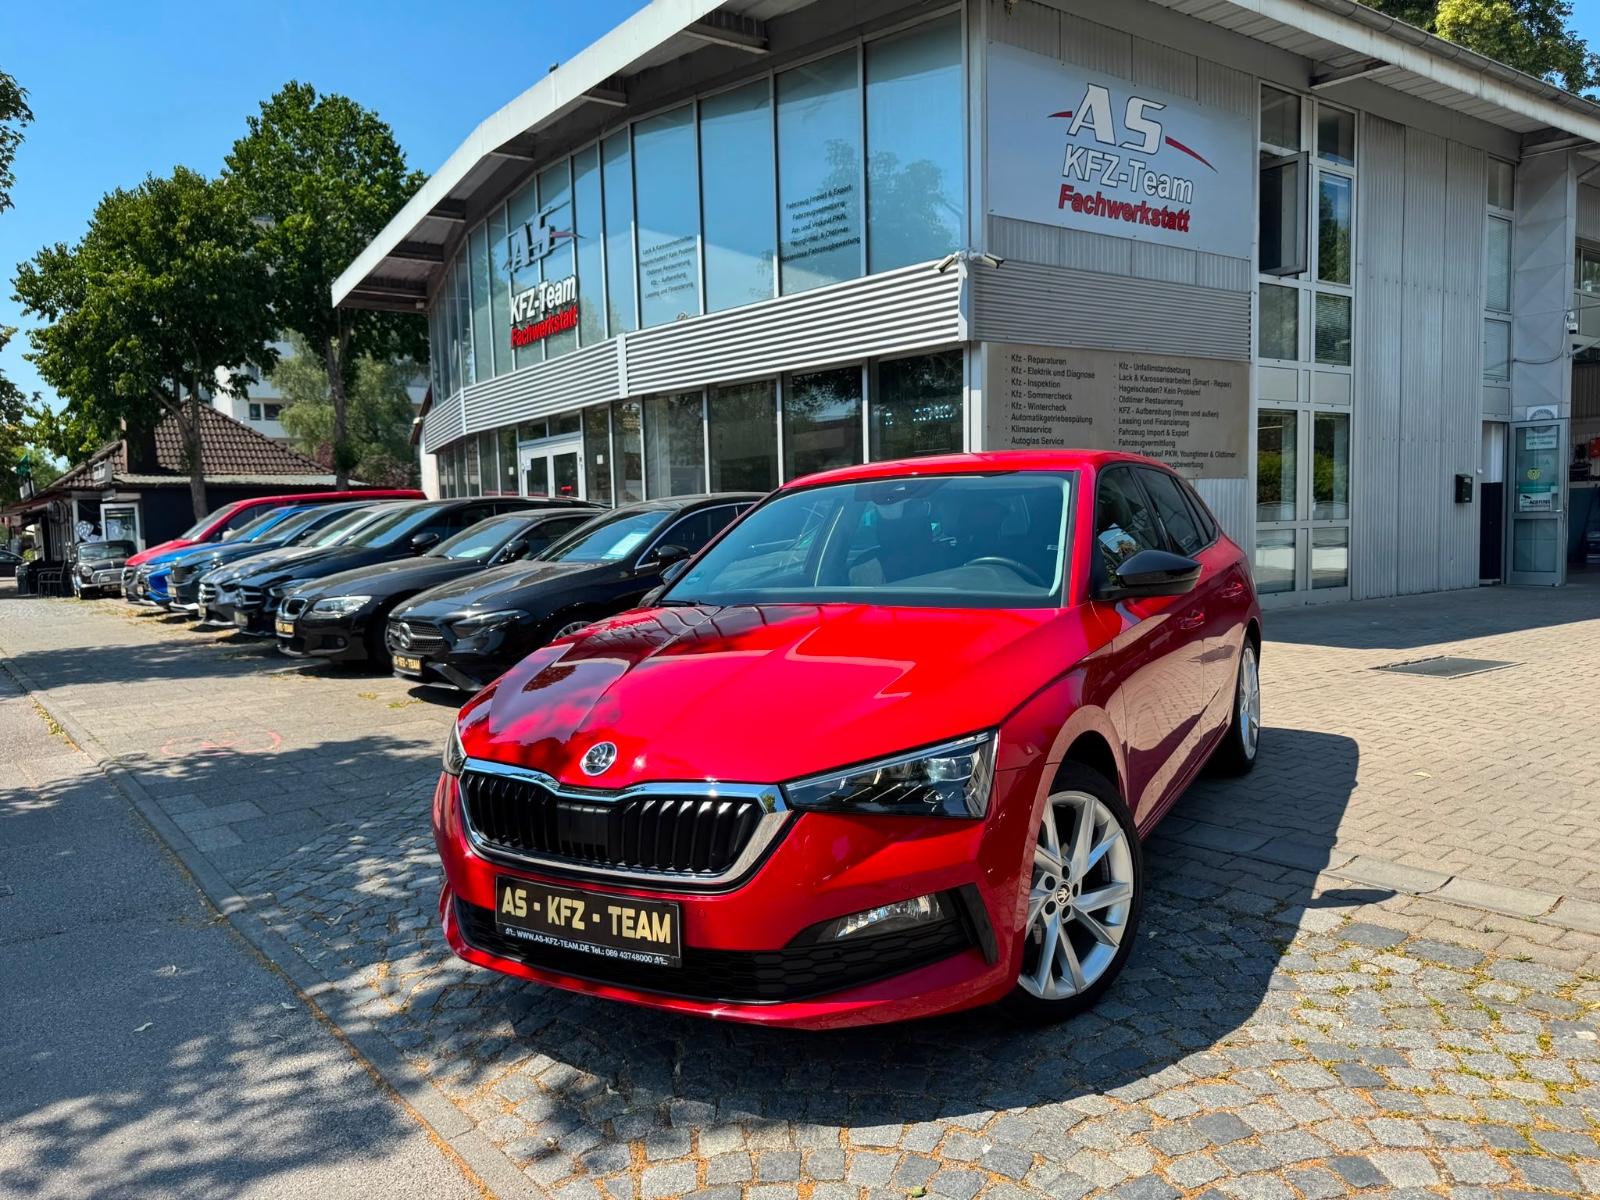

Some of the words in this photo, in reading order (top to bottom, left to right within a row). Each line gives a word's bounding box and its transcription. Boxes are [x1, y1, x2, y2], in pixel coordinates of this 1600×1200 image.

[1066, 82, 1167, 156] AS
[1062, 143, 1194, 204] KFZ-Team
[1058, 183, 1191, 232] Fachwerkstatt
[508, 207, 553, 273] AS
[510, 275, 577, 325] KFZ-Team
[511, 305, 578, 349] Fachwerkstatt
[1011, 354, 1022, 362] Kfz
[1027, 355, 1067, 365] Reparaturen
[1011, 366, 1022, 374] Kfz
[1027, 367, 1052, 376] Elektrik
[1053, 369, 1065, 377] und
[1066, 370, 1095, 379] Diagnose
[1118, 373, 1132, 381] Lack
[1011, 378, 1022, 386] Kfz
[1027, 378, 1061, 388] Inspektion
[1011, 390, 1022, 398] Kfz
[1027, 391, 1072, 400] Sommercheck
[1118, 385, 1162, 394] Hagelschaden?
[1164, 386, 1176, 394] Kein
[1011, 402, 1022, 410] Kfz
[1027, 402, 1067, 411] Wintercheck
[1118, 395, 1143, 403] Oldtimer
[1145, 397, 1184, 407] Restaurierung
[1118, 406, 1131, 414] KFZ
[1136, 407, 1171, 417] Aufbereitung
[1011, 413, 1093, 425] Automatikgetriebespülung
[1118, 418, 1142, 427] Leasing
[1155, 418, 1190, 428] Finanzierung
[1011, 425, 1052, 434] Klimaservice
[1118, 428, 1145, 438] Fahrzeug
[1146, 429, 1165, 437] Import
[1171, 429, 1189, 437] Export
[1011, 437, 1040, 446] Autoglas
[1041, 437, 1065, 445] Service
[1118, 439, 1176, 448] Fahrzeugvermittlung
[501, 886, 527, 918] AS
[547, 895, 585, 930] KFZ
[608, 905, 671, 944] TEAM
[517, 930, 590, 953] WWW.AS-KFZ-TEAM.DE
[591, 946, 605, 956] Tel.:
